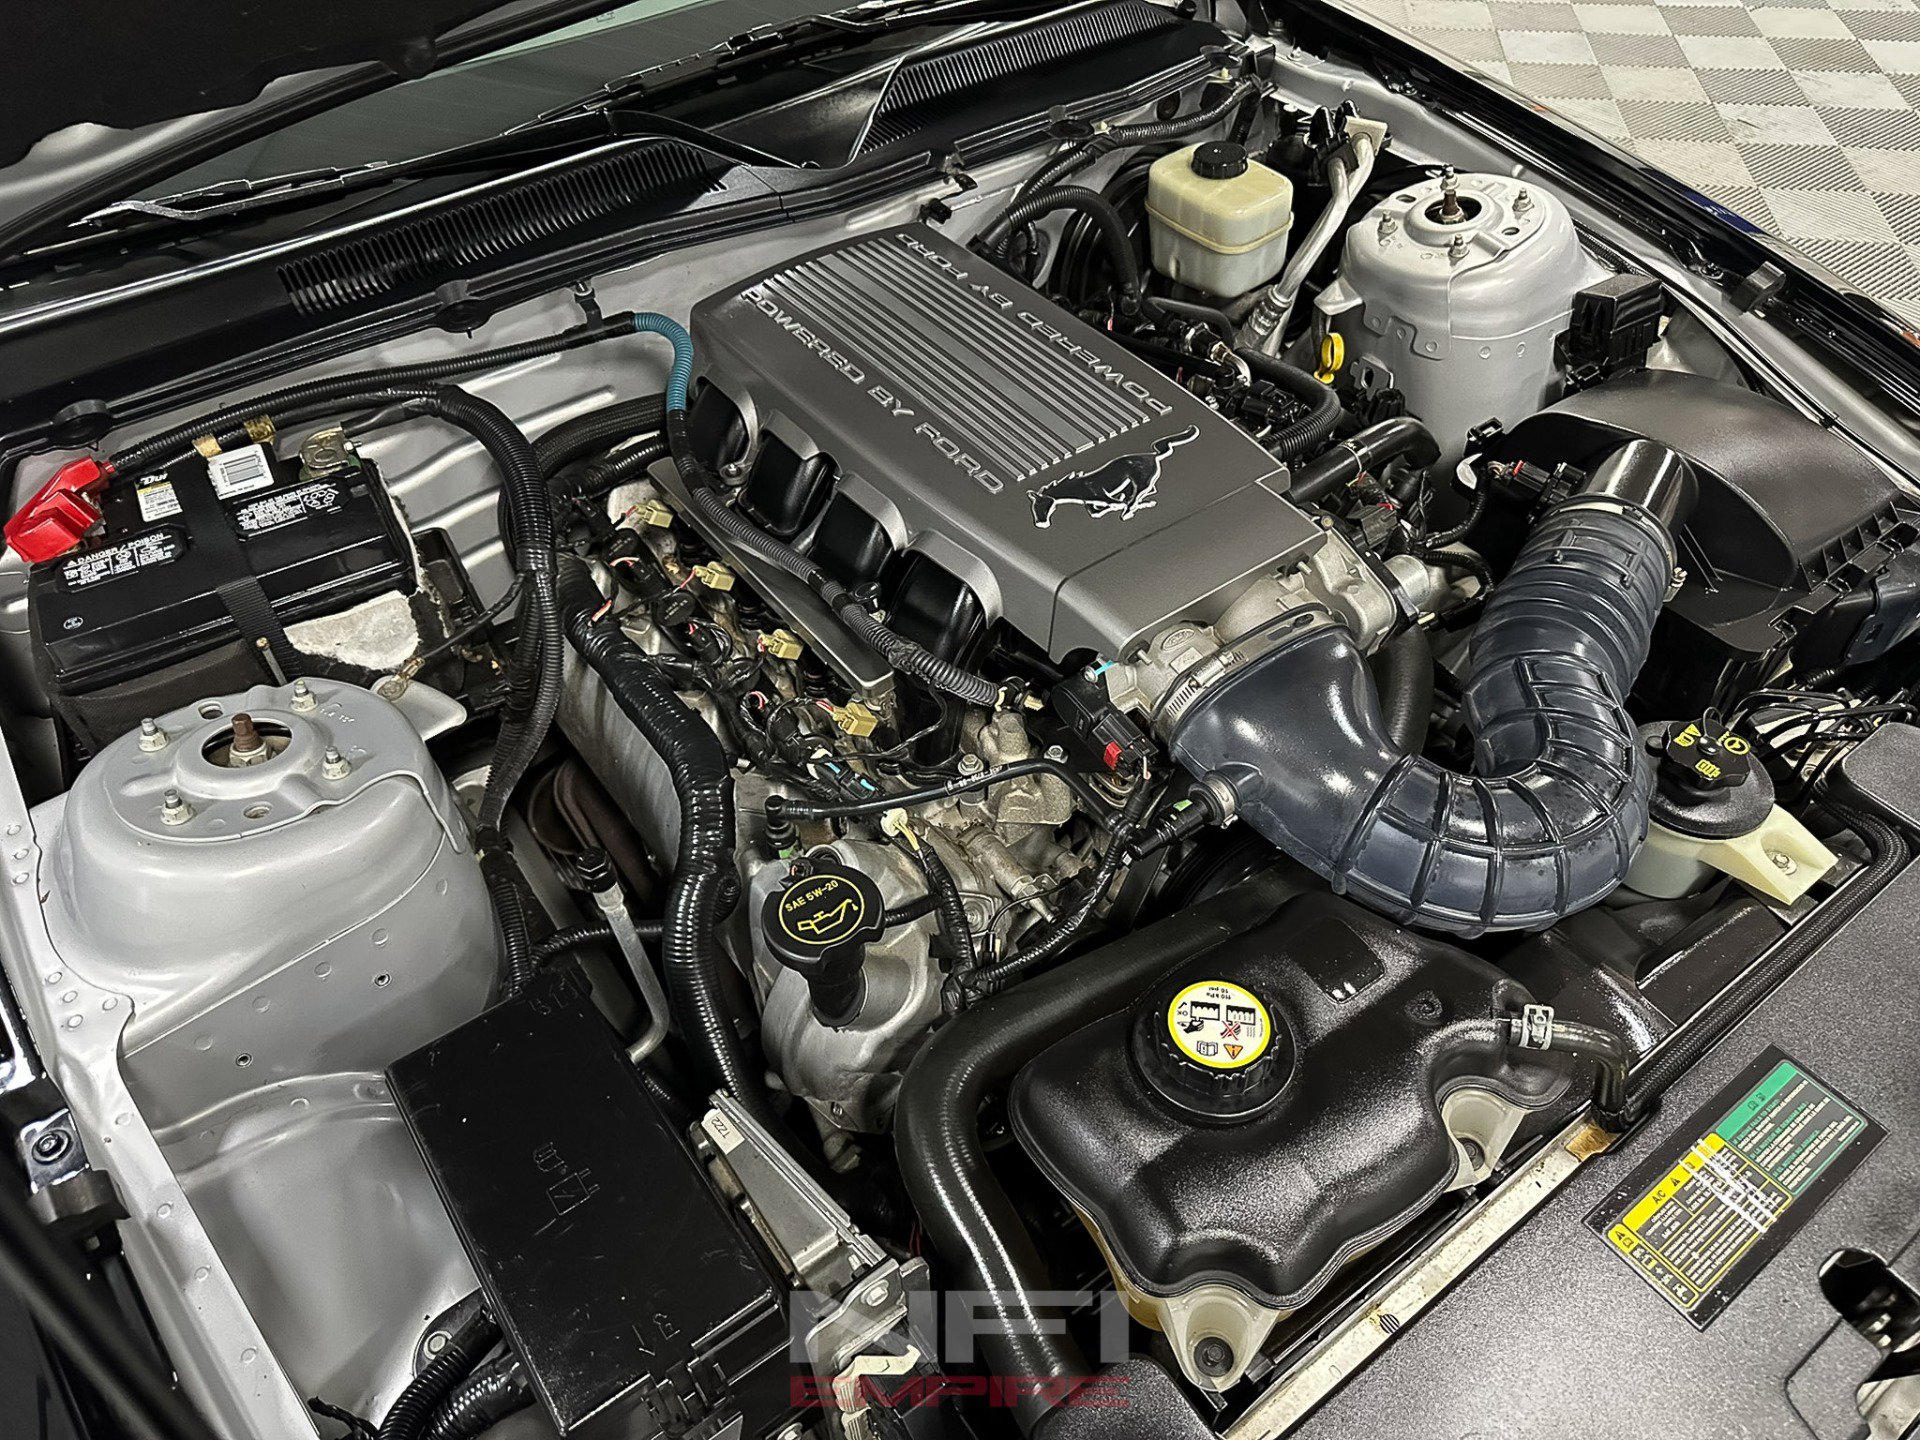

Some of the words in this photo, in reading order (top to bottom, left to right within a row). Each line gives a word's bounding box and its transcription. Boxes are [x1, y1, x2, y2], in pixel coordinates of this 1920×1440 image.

[895, 233, 969, 281] FORD
[969, 283, 1014, 310] BY
[1017, 311, 1173, 416] POWERED
[740, 287, 866, 385] POWERED
[867, 385, 915, 417] BY
[913, 422, 1004, 494] FORD
[78, 546, 118, 564] DANGER
[128, 532, 164, 548] POISON
[785, 896, 807, 911] SAE
[805, 880, 839, 901] 5W-20
